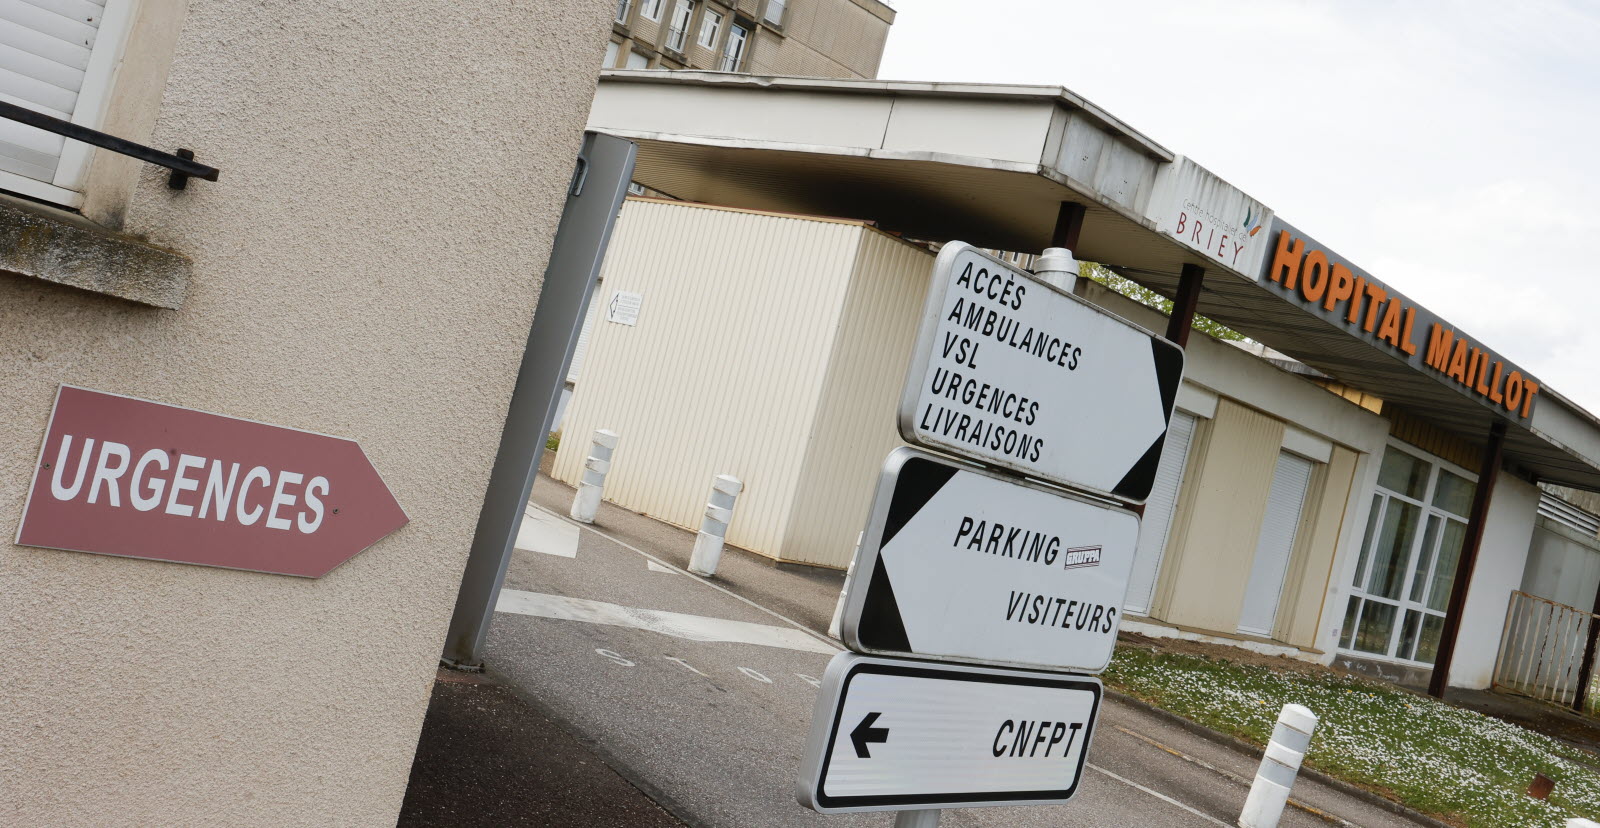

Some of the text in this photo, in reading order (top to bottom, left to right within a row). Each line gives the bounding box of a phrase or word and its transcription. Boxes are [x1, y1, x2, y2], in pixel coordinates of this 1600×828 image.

[1176, 212, 1244, 265] BRIEY
[956, 262, 1026, 311] ACCÈS
[948, 297, 1082, 371] AMBULANCES
[1270, 229, 1538, 418] HOPITAL MAILLOT
[942, 331, 980, 370] VSL
[931, 367, 1039, 426] URGENCES
[920, 403, 1044, 463] LIVRAISONS
[50, 434, 330, 534] URGENCES
[953, 516, 1061, 566] PARKING
[1065, 548, 1100, 566] GRUPPA
[1006, 590, 1117, 635] VISITEURS
[992, 719, 1083, 758] CNFPT
